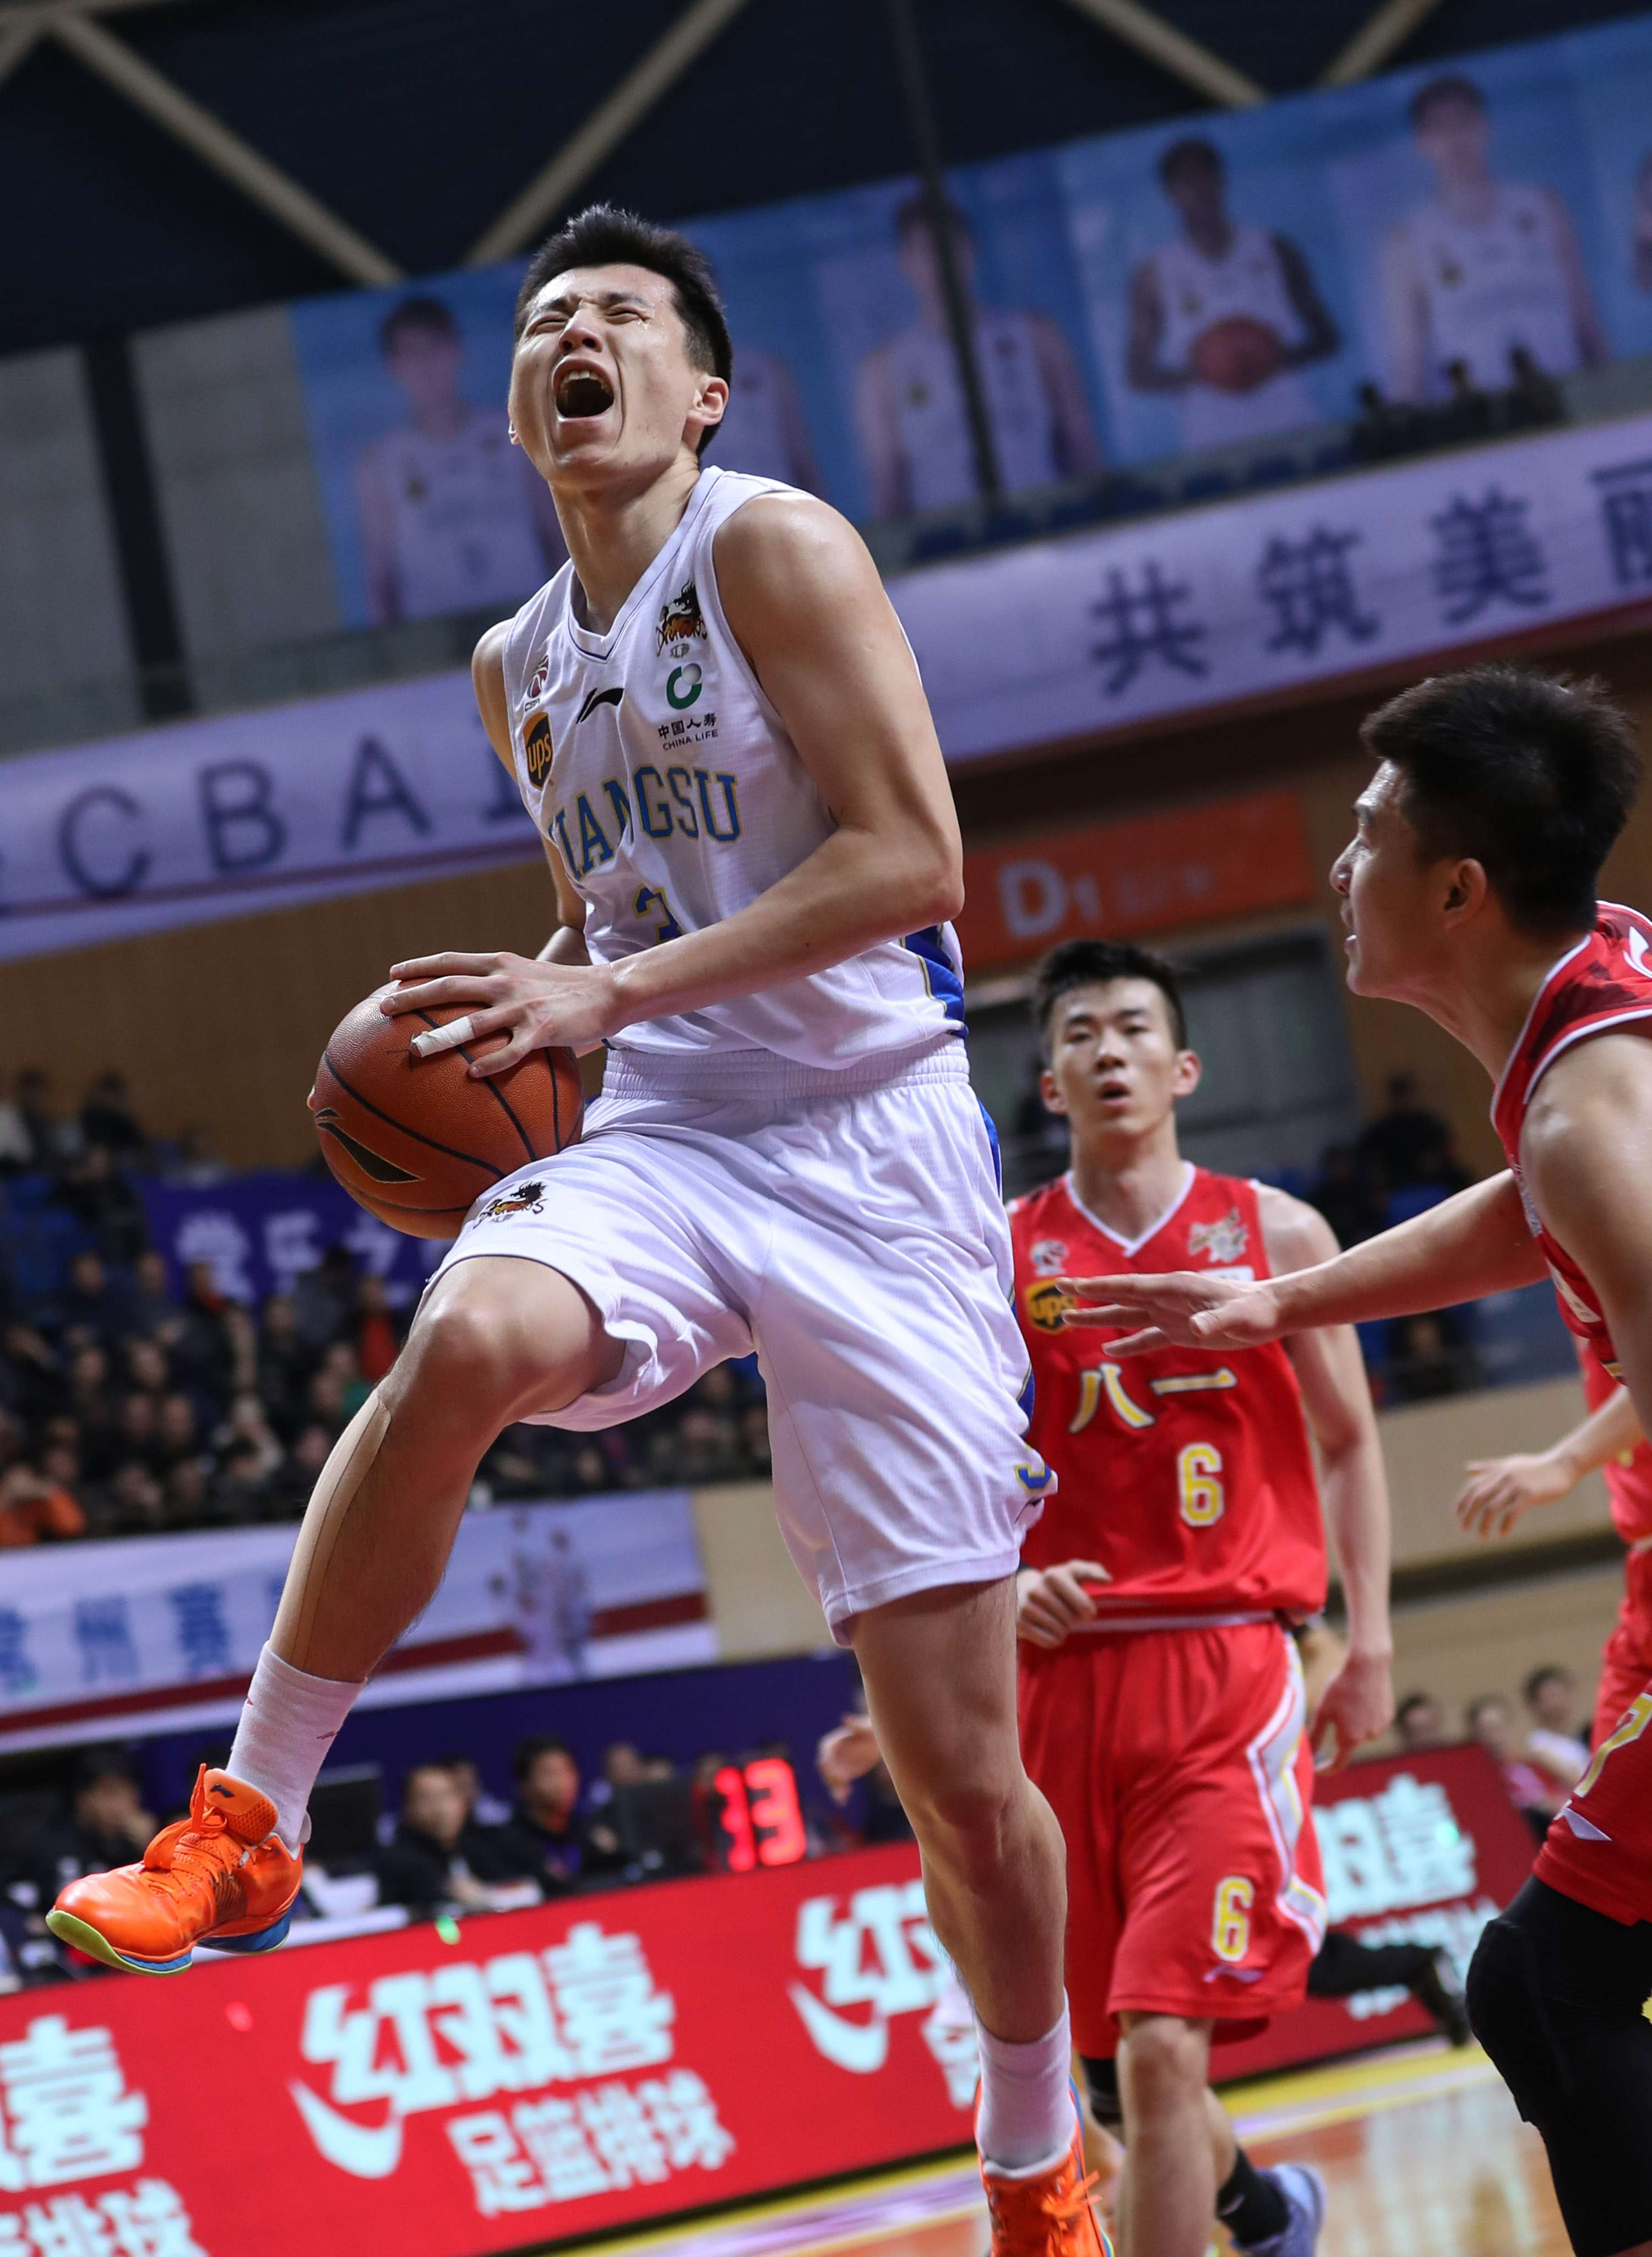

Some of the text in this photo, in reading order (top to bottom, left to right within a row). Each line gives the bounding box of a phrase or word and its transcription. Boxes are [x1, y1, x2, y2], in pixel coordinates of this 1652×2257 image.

[528, 733, 551, 780] ups
[657, 713, 716, 739] 中国人寿
[662, 728, 719, 751] CHINA LIFE
[1068, 1362, 1237, 1433] 八一
[1177, 1443, 1224, 1527] 6
[1212, 1875, 1254, 1962] 6
[287, 1922, 677, 2178] 红双喜
